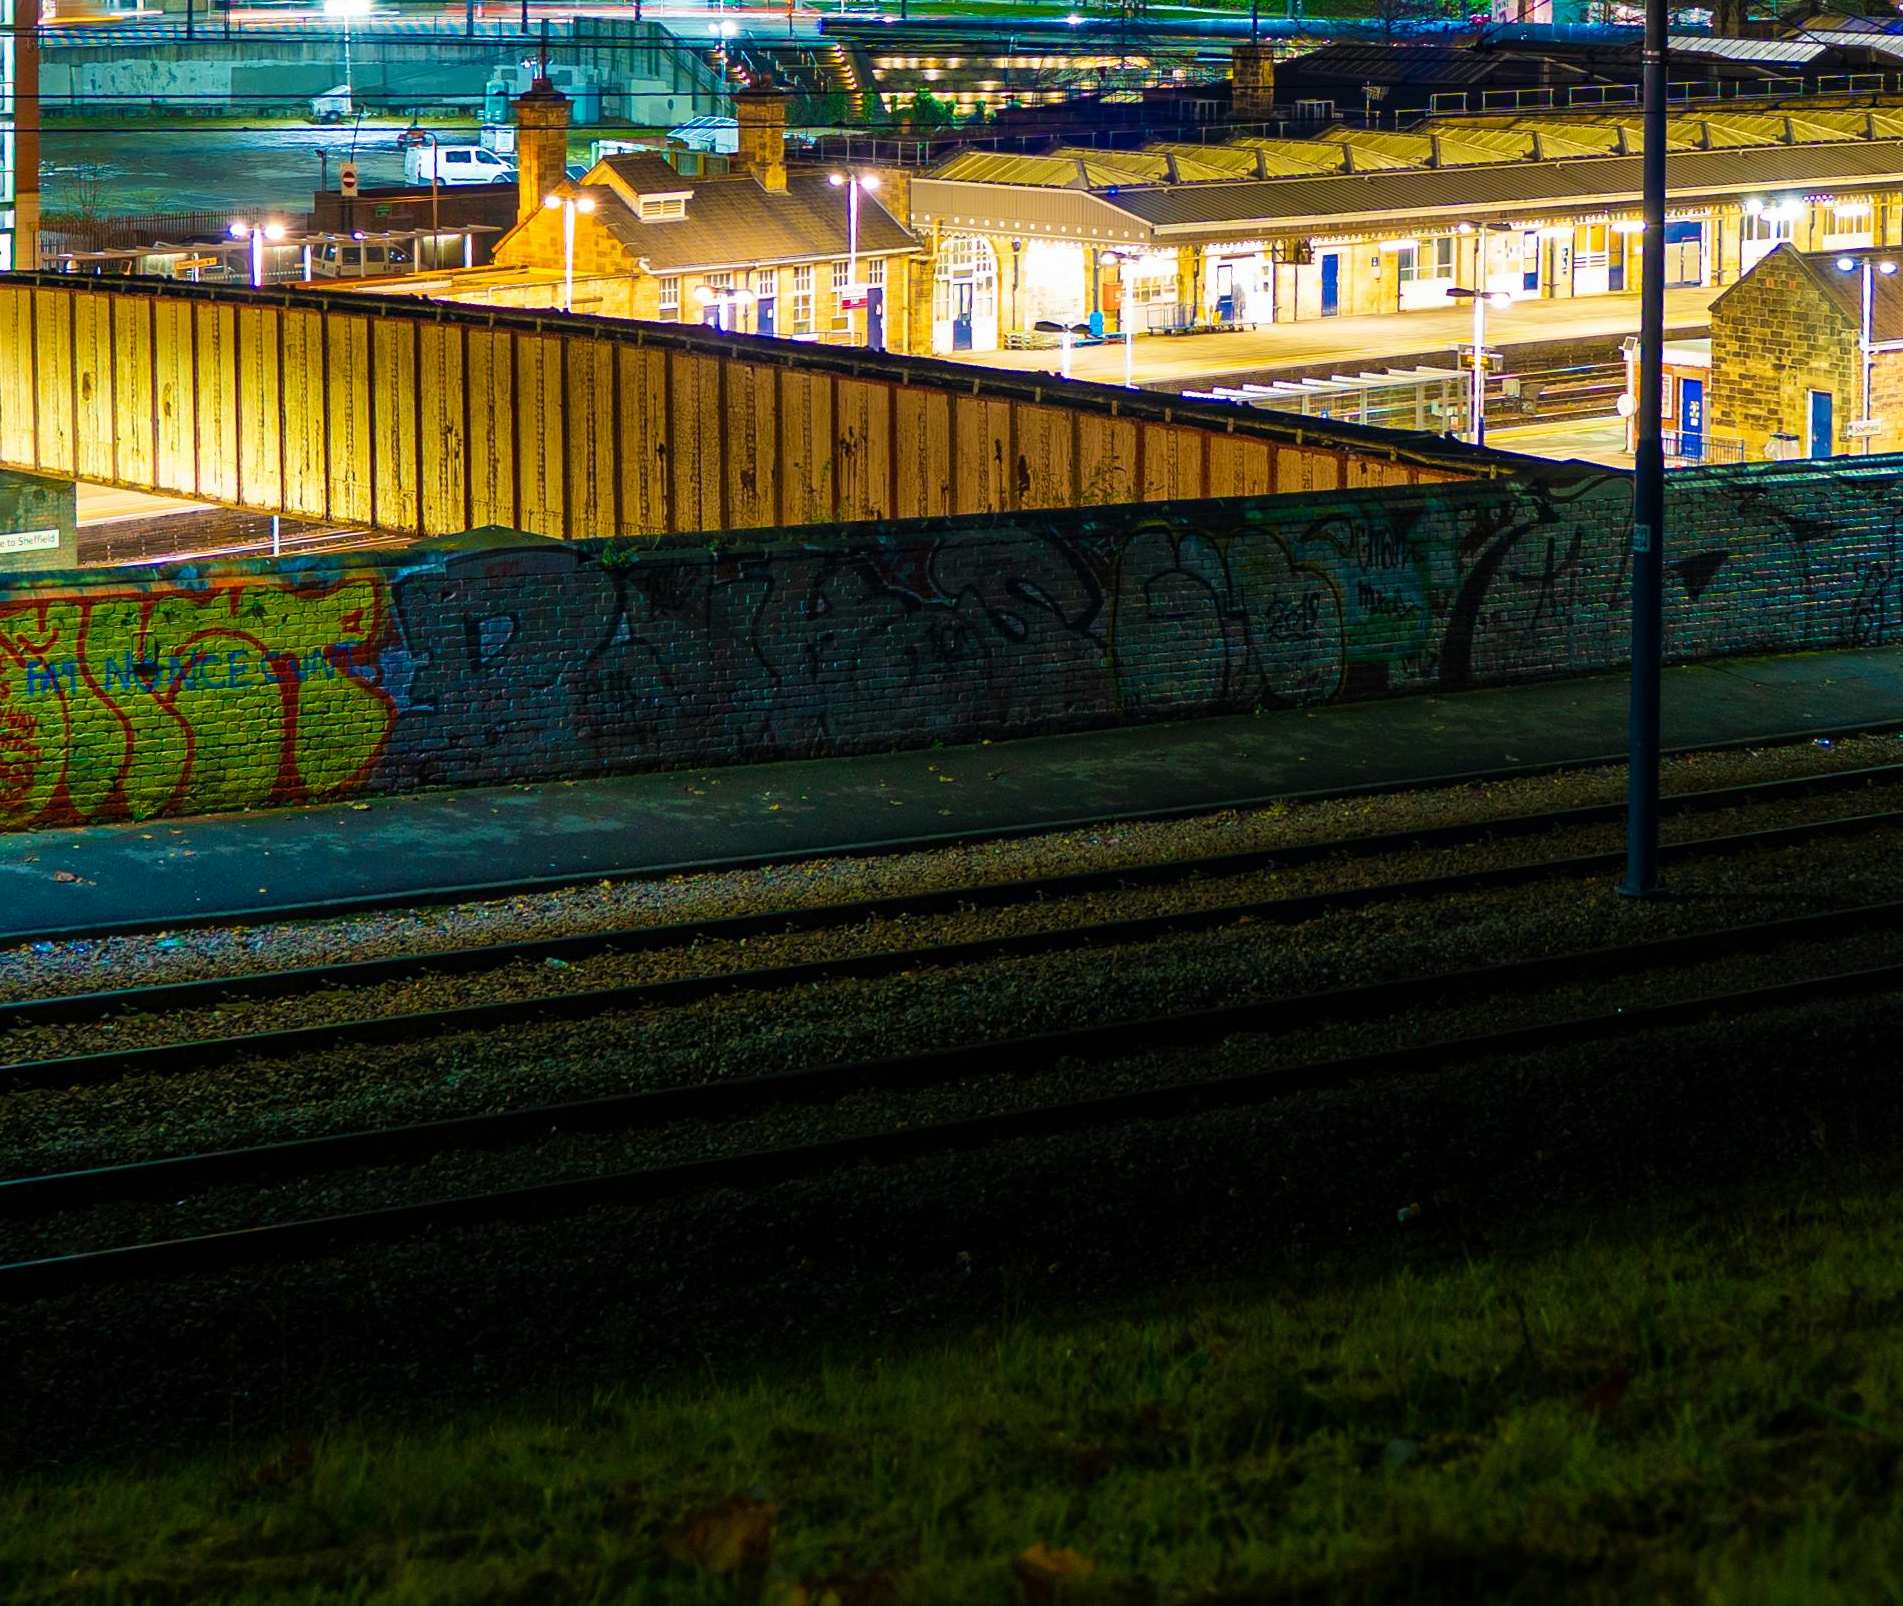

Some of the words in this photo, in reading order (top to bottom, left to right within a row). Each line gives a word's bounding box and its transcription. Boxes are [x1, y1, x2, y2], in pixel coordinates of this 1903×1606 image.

[7, 538, 16, 547] to
[18, 533, 55, 546] Sheffield
[104, 649, 252, 692] NONCE
